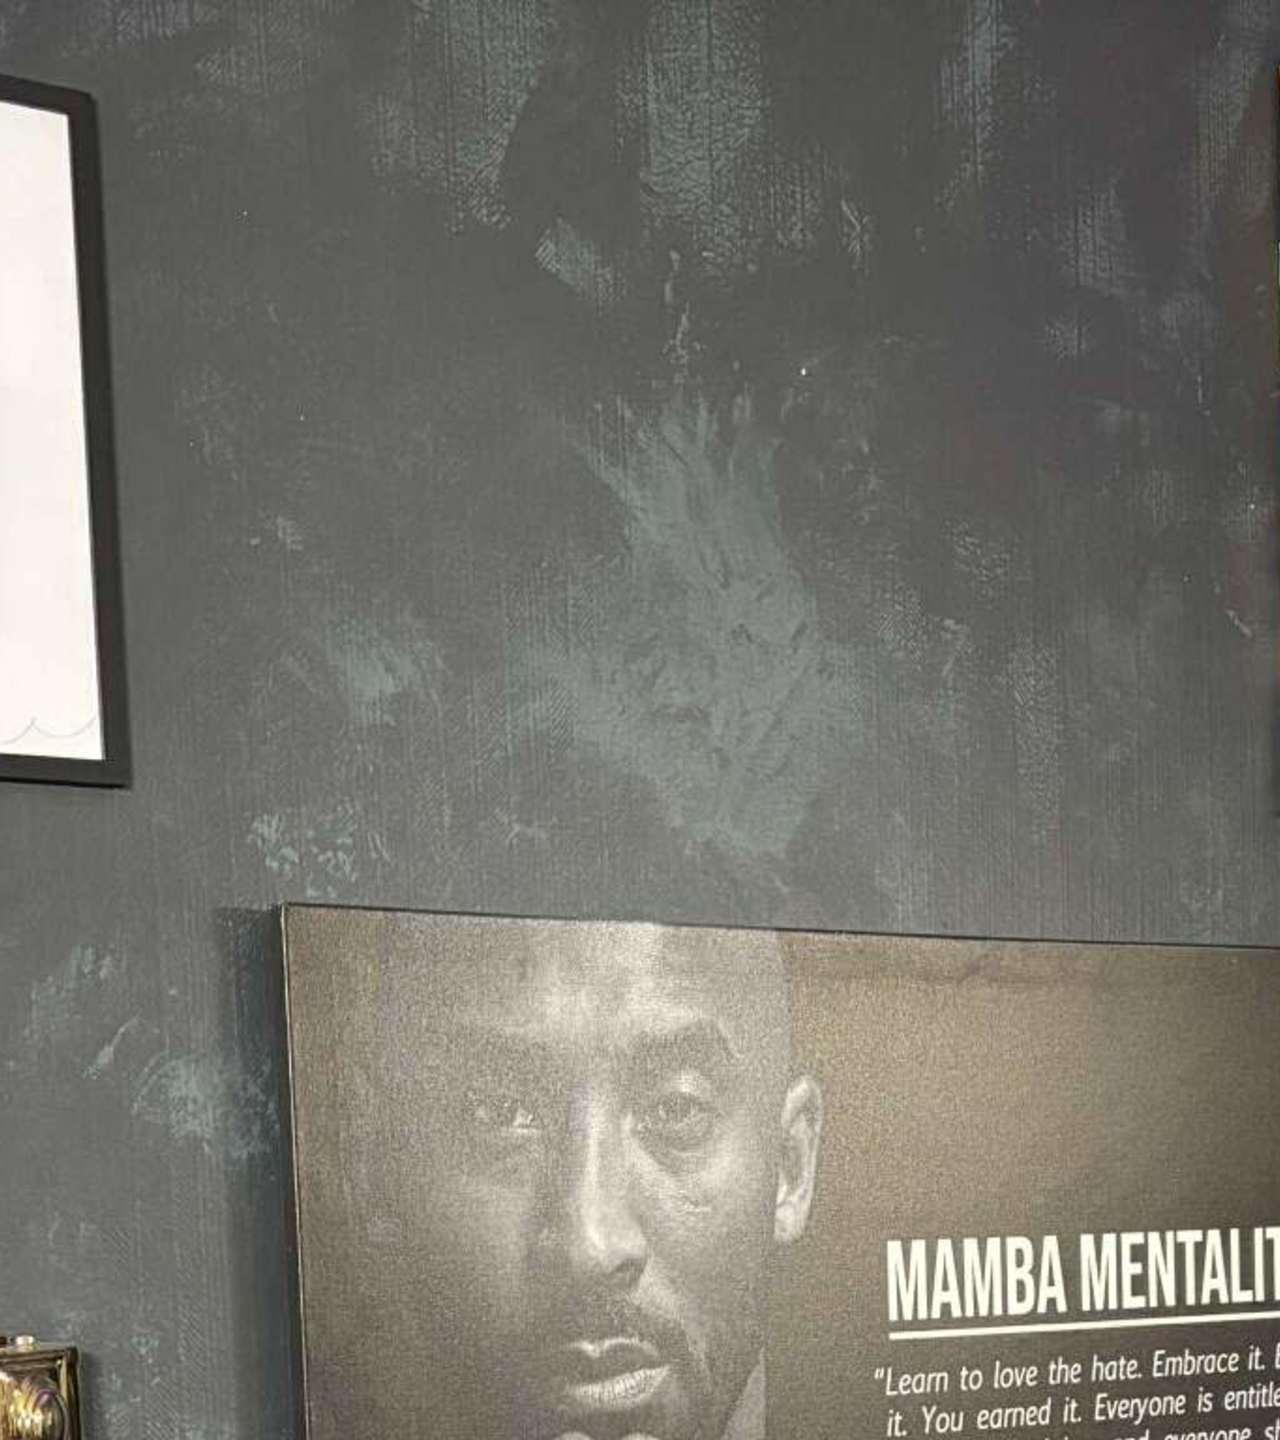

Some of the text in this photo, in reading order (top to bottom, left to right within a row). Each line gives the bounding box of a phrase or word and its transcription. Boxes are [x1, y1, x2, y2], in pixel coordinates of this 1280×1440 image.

[886, 1235, 1067, 1322] MAMBA
[959, 1366, 984, 1392] to
[993, 1360, 1039, 1389] love
[1048, 1356, 1082, 1385] the
[1091, 1354, 1143, 1382] hate.
[1152, 1348, 1240, 1378] Embrace
[1247, 1344, 1266, 1371] it.
[886, 1409, 908, 1438] it.
[921, 1405, 964, 1435] You
[976, 1396, 1052, 1430] earned
[1063, 1396, 1082, 1424] it.
[1093, 1392, 1187, 1426] Everyone
[1197, 1386, 1213, 1413] is
